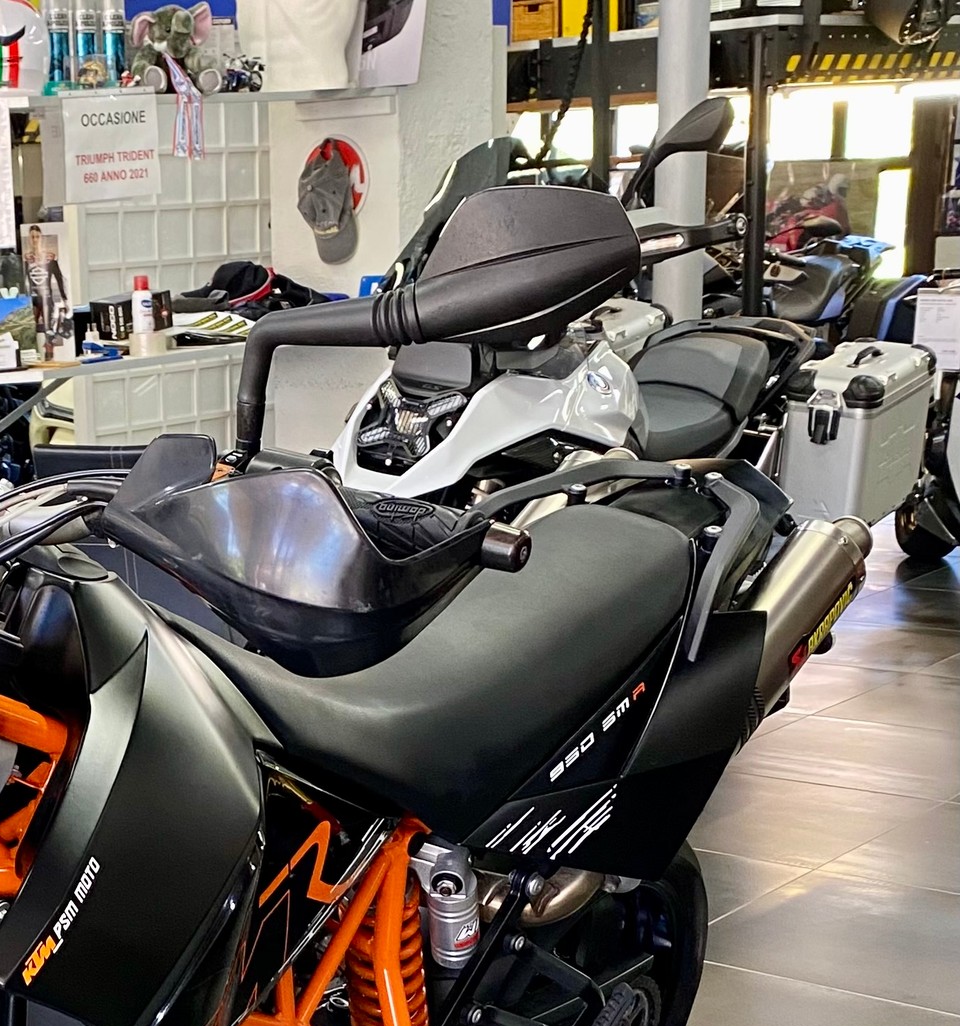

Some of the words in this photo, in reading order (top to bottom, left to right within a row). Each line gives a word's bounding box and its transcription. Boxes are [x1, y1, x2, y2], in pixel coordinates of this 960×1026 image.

[81, 110, 146, 127] OCCASIONE
[75, 151, 115, 166] TRIUMPH
[117, 149, 155, 162] TRIDENT
[83, 171, 99, 184] 660
[100, 169, 127, 182] ANNO
[129, 167, 149, 180] 2021
[378, 502, 427, 521] domino
[549, 731, 595, 782] 950
[73, 856, 101, 904] MOTO
